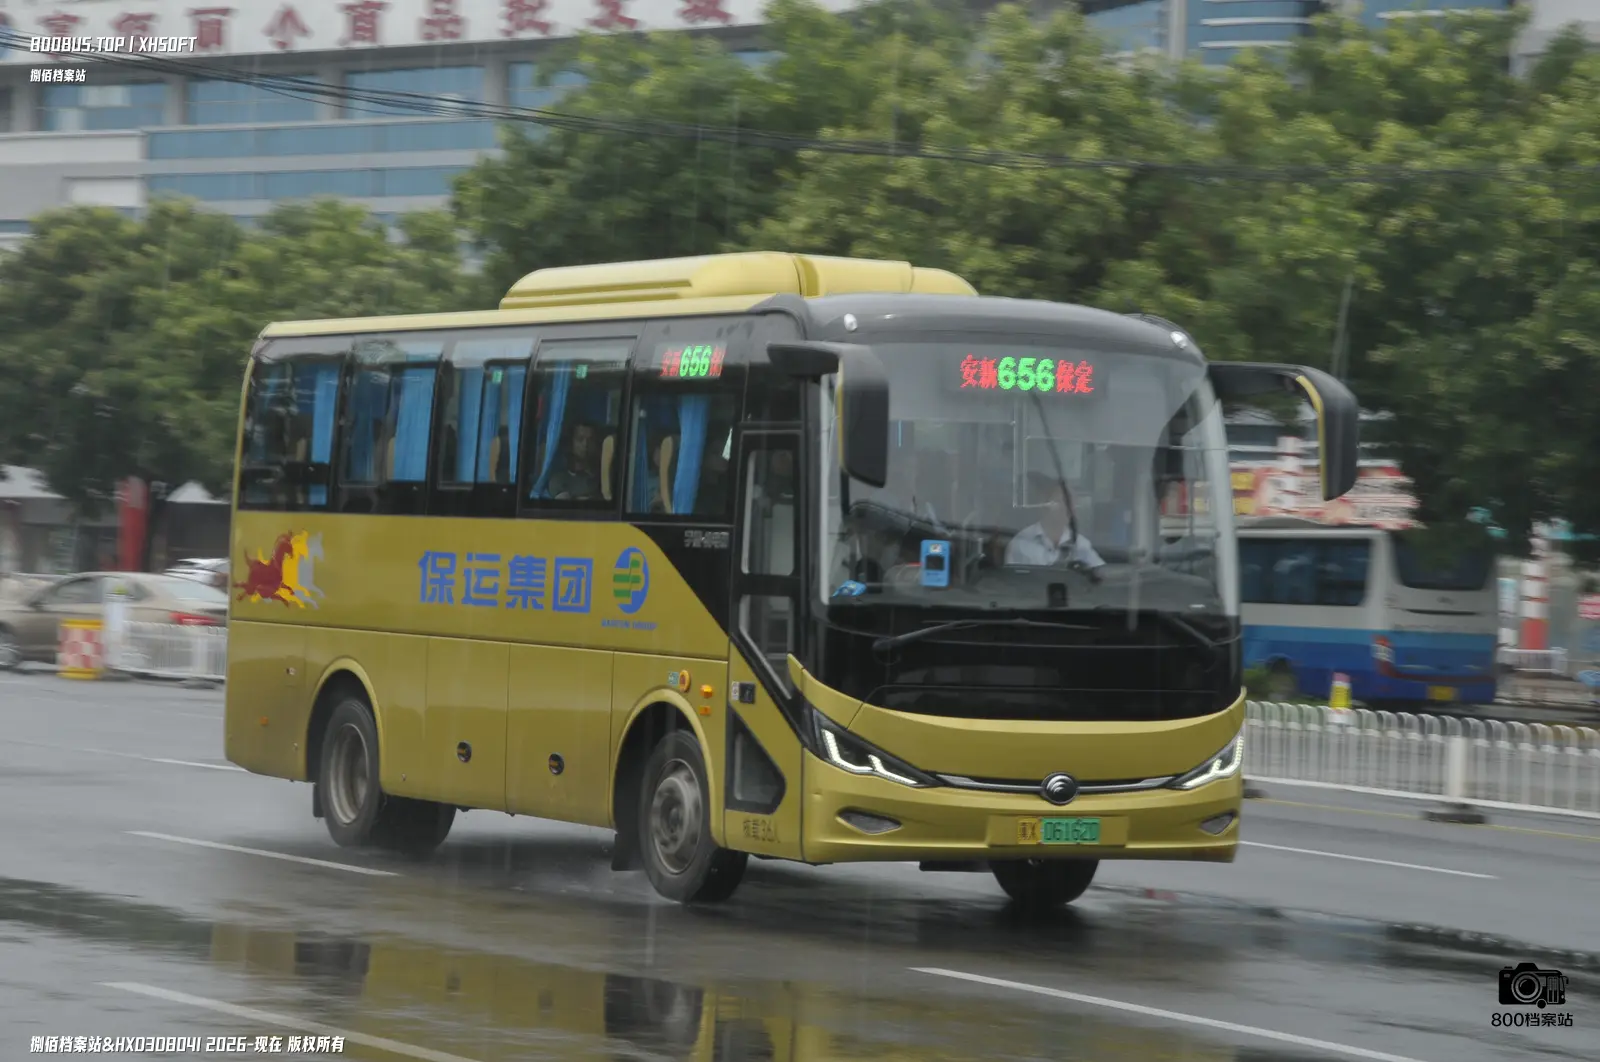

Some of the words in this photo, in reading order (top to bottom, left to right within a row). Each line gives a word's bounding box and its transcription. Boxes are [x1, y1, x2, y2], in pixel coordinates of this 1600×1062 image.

[680, 345, 712, 377] 656
[998, 356, 1055, 392] 656
[418, 549, 594, 613] 保运集团
